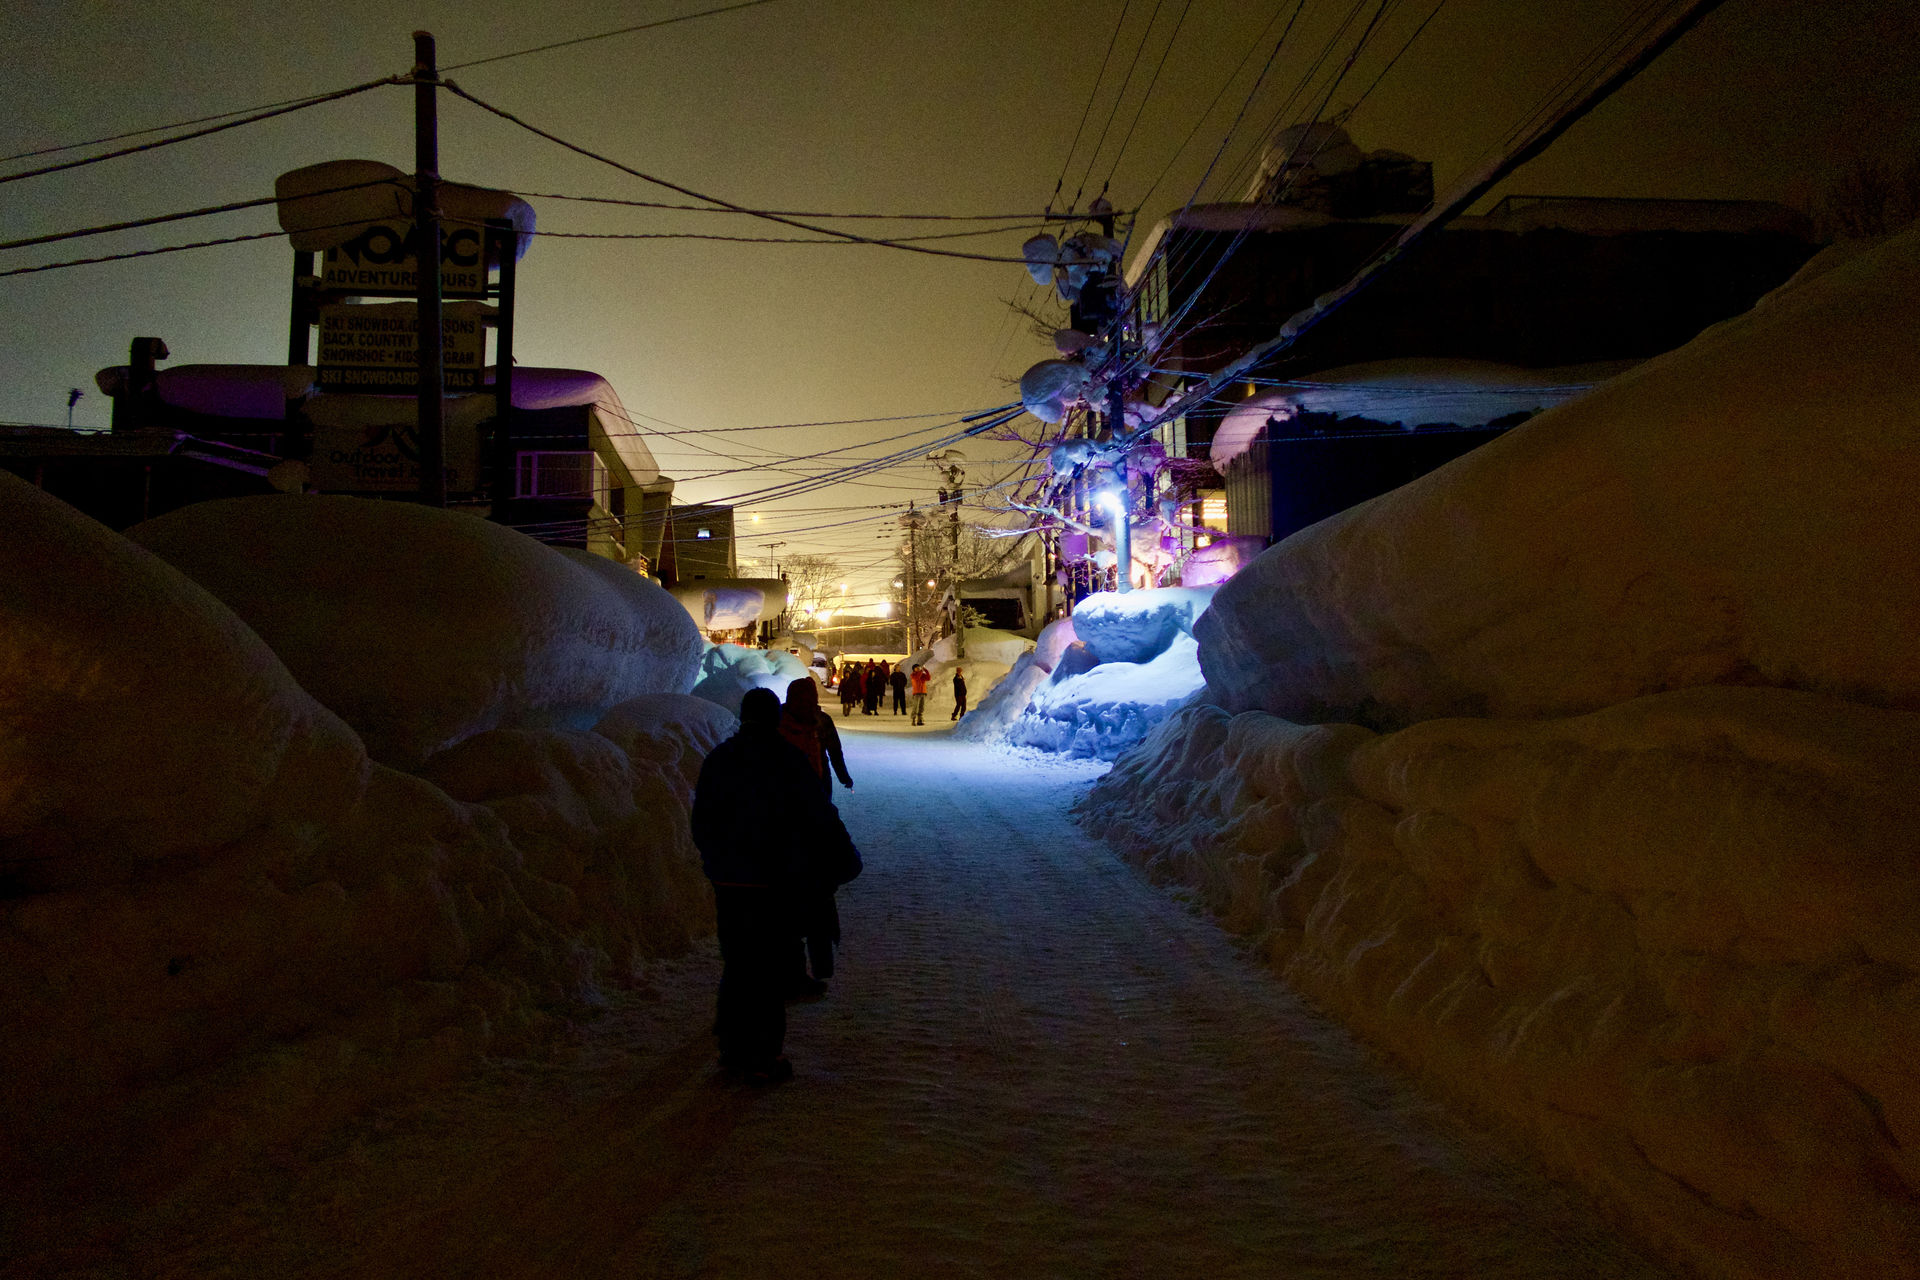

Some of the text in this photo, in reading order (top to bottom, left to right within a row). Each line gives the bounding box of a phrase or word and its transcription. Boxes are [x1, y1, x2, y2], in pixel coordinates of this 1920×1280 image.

[327, 270, 418, 285] ADVENTURE
[324, 316, 343, 330] SKI
[442, 319, 476, 333] SONS
[324, 332, 414, 348] BACK COUNTRY
[322, 348, 385, 362] SNOWSHOE
[443, 351, 474, 365] GRAM
[320, 370, 475, 387] SKI SNOWBOARD TALS
[330, 448, 400, 464] Outdoor
